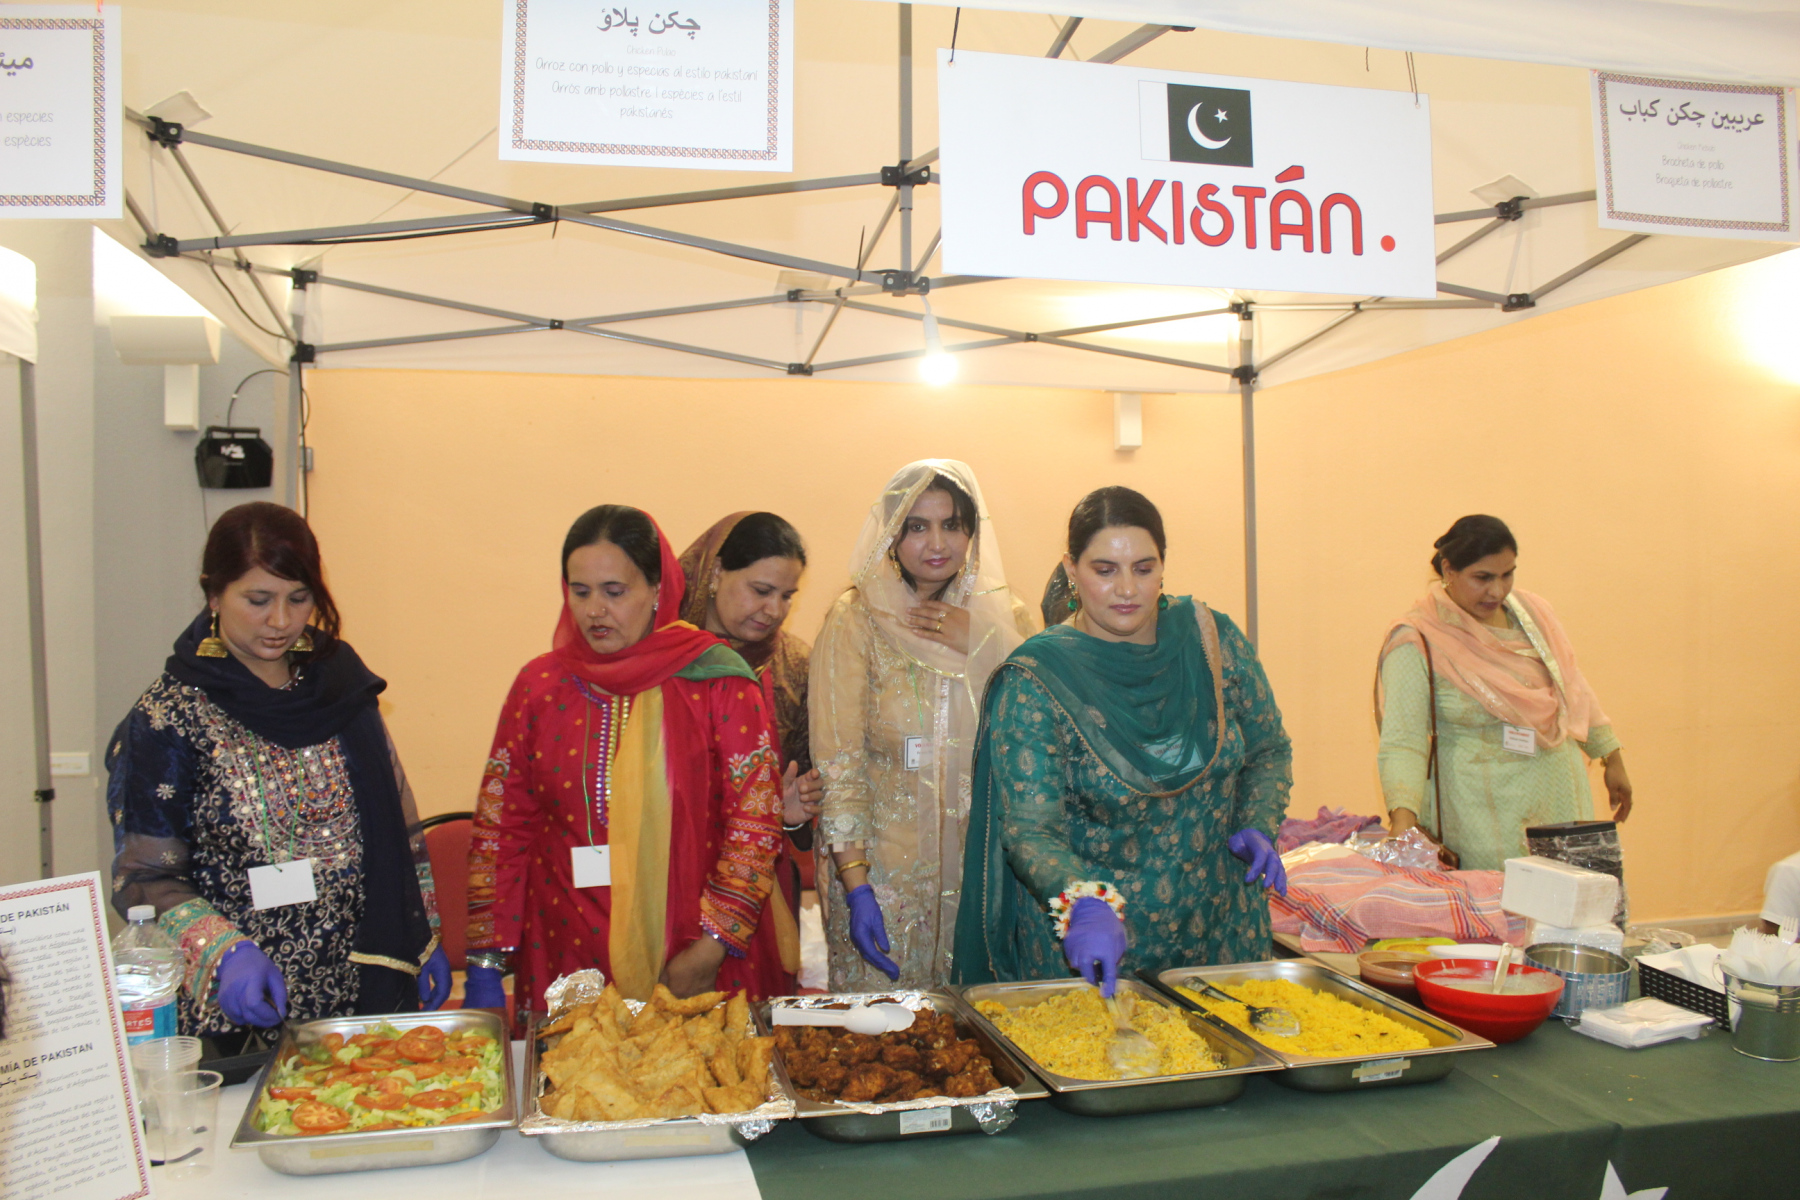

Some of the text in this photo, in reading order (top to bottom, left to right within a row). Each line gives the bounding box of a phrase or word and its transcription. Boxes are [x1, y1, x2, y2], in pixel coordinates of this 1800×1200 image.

[626, 45, 654, 55] Chicken
[536, 57, 565, 71] Arroz
[569, 62, 588, 72] con
[592, 62, 614, 75] pollo
[618, 66, 624, 78] y
[627, 66, 670, 78] especias
[674, 65, 682, 78] al
[686, 66, 710, 78] estilo
[584, 84, 606, 96] amb
[610, 85, 652, 98] pollastre
[662, 88, 704, 101] espècies
[708, 92, 714, 101] a
[6, 112, 54, 124] especies
[5, 135, 52, 148] espècies
[1697, 159, 1706, 169] de
[1691, 178, 1700, 188] de
[0, 902, 70, 924] DE PAKISTÁN
[24, 1056, 38, 1068] DE
[40, 1042, 94, 1063] PAKISTAN
